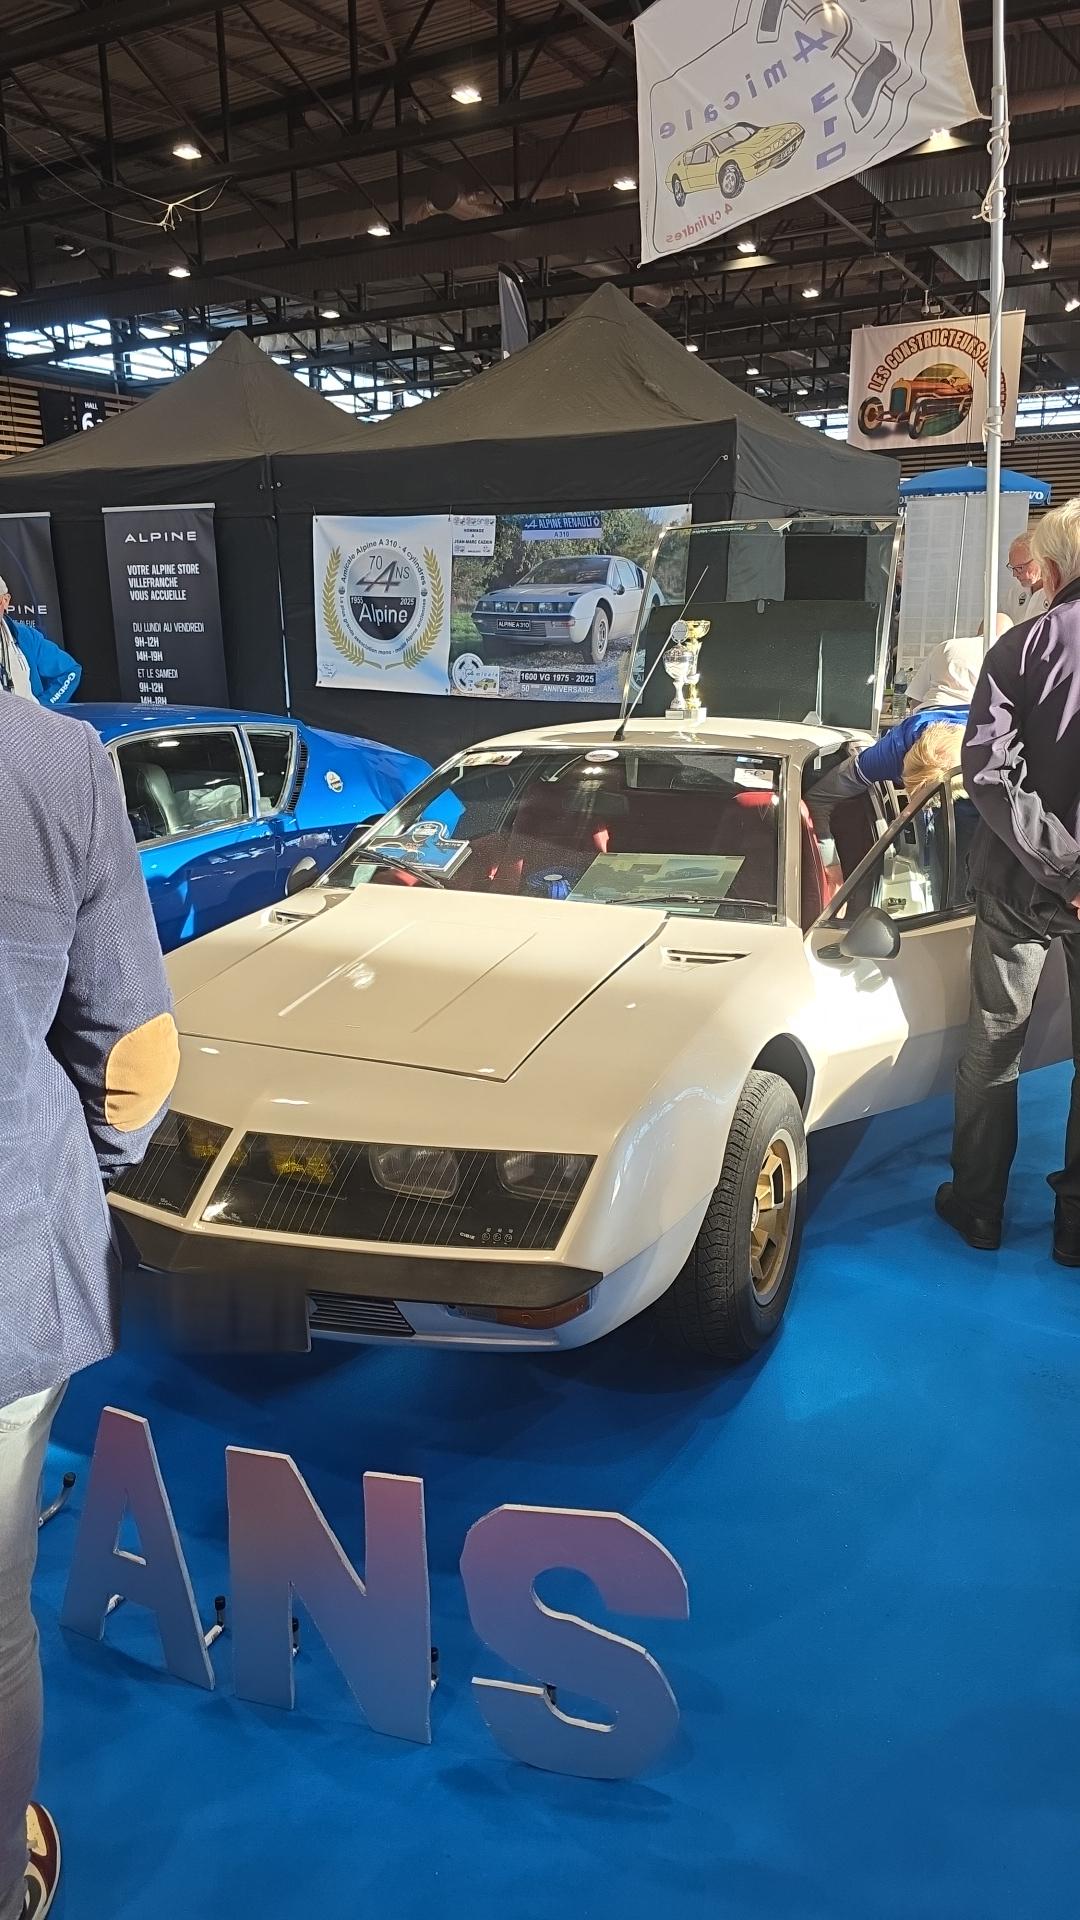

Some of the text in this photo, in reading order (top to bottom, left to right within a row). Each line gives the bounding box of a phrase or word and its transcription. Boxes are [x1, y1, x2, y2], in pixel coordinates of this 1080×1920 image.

[868, 328, 987, 393] LES CONSTRUCTEURS
[84, 401, 98, 410] HALL
[538, 518, 562, 529] ALPINE
[563, 516, 592, 528] RENAULT
[125, 531, 197, 543] ALPINE
[341, 553, 356, 584] Amicale
[355, 540, 377, 555] Alpine
[385, 539, 398, 548] 310
[406, 551, 427, 586] cylindres
[369, 555, 383, 570] 70
[127, 563, 200, 575] VOTRE ALPINE STORE
[128, 577, 178, 588] VILLEFRANCHE
[129, 589, 187, 601] VOUS ACCUEILLE
[400, 597, 415, 606] 2025
[6, 605, 47, 615] PINE
[359, 603, 408, 626] Alpine
[132, 622, 205, 632] DU LUNDI AU VENDREDI
[134, 636, 160, 647] 9H-12H
[135, 651, 163, 661] 14H-19H
[137, 668, 179, 678] ET LE SAMEDI
[521, 672, 538, 681] 1600
[540, 673, 551, 682] VG
[552, 674, 570, 682] 1975
[575, 675, 595, 683] 2025
[49, 671, 76, 704] GORDINI
[138, 682, 164, 693] 9H-12H
[521, 684, 530, 692] 50
[542, 685, 594, 694] ANNIVERSAIRE
[59, 1405, 691, 1781] ANS
